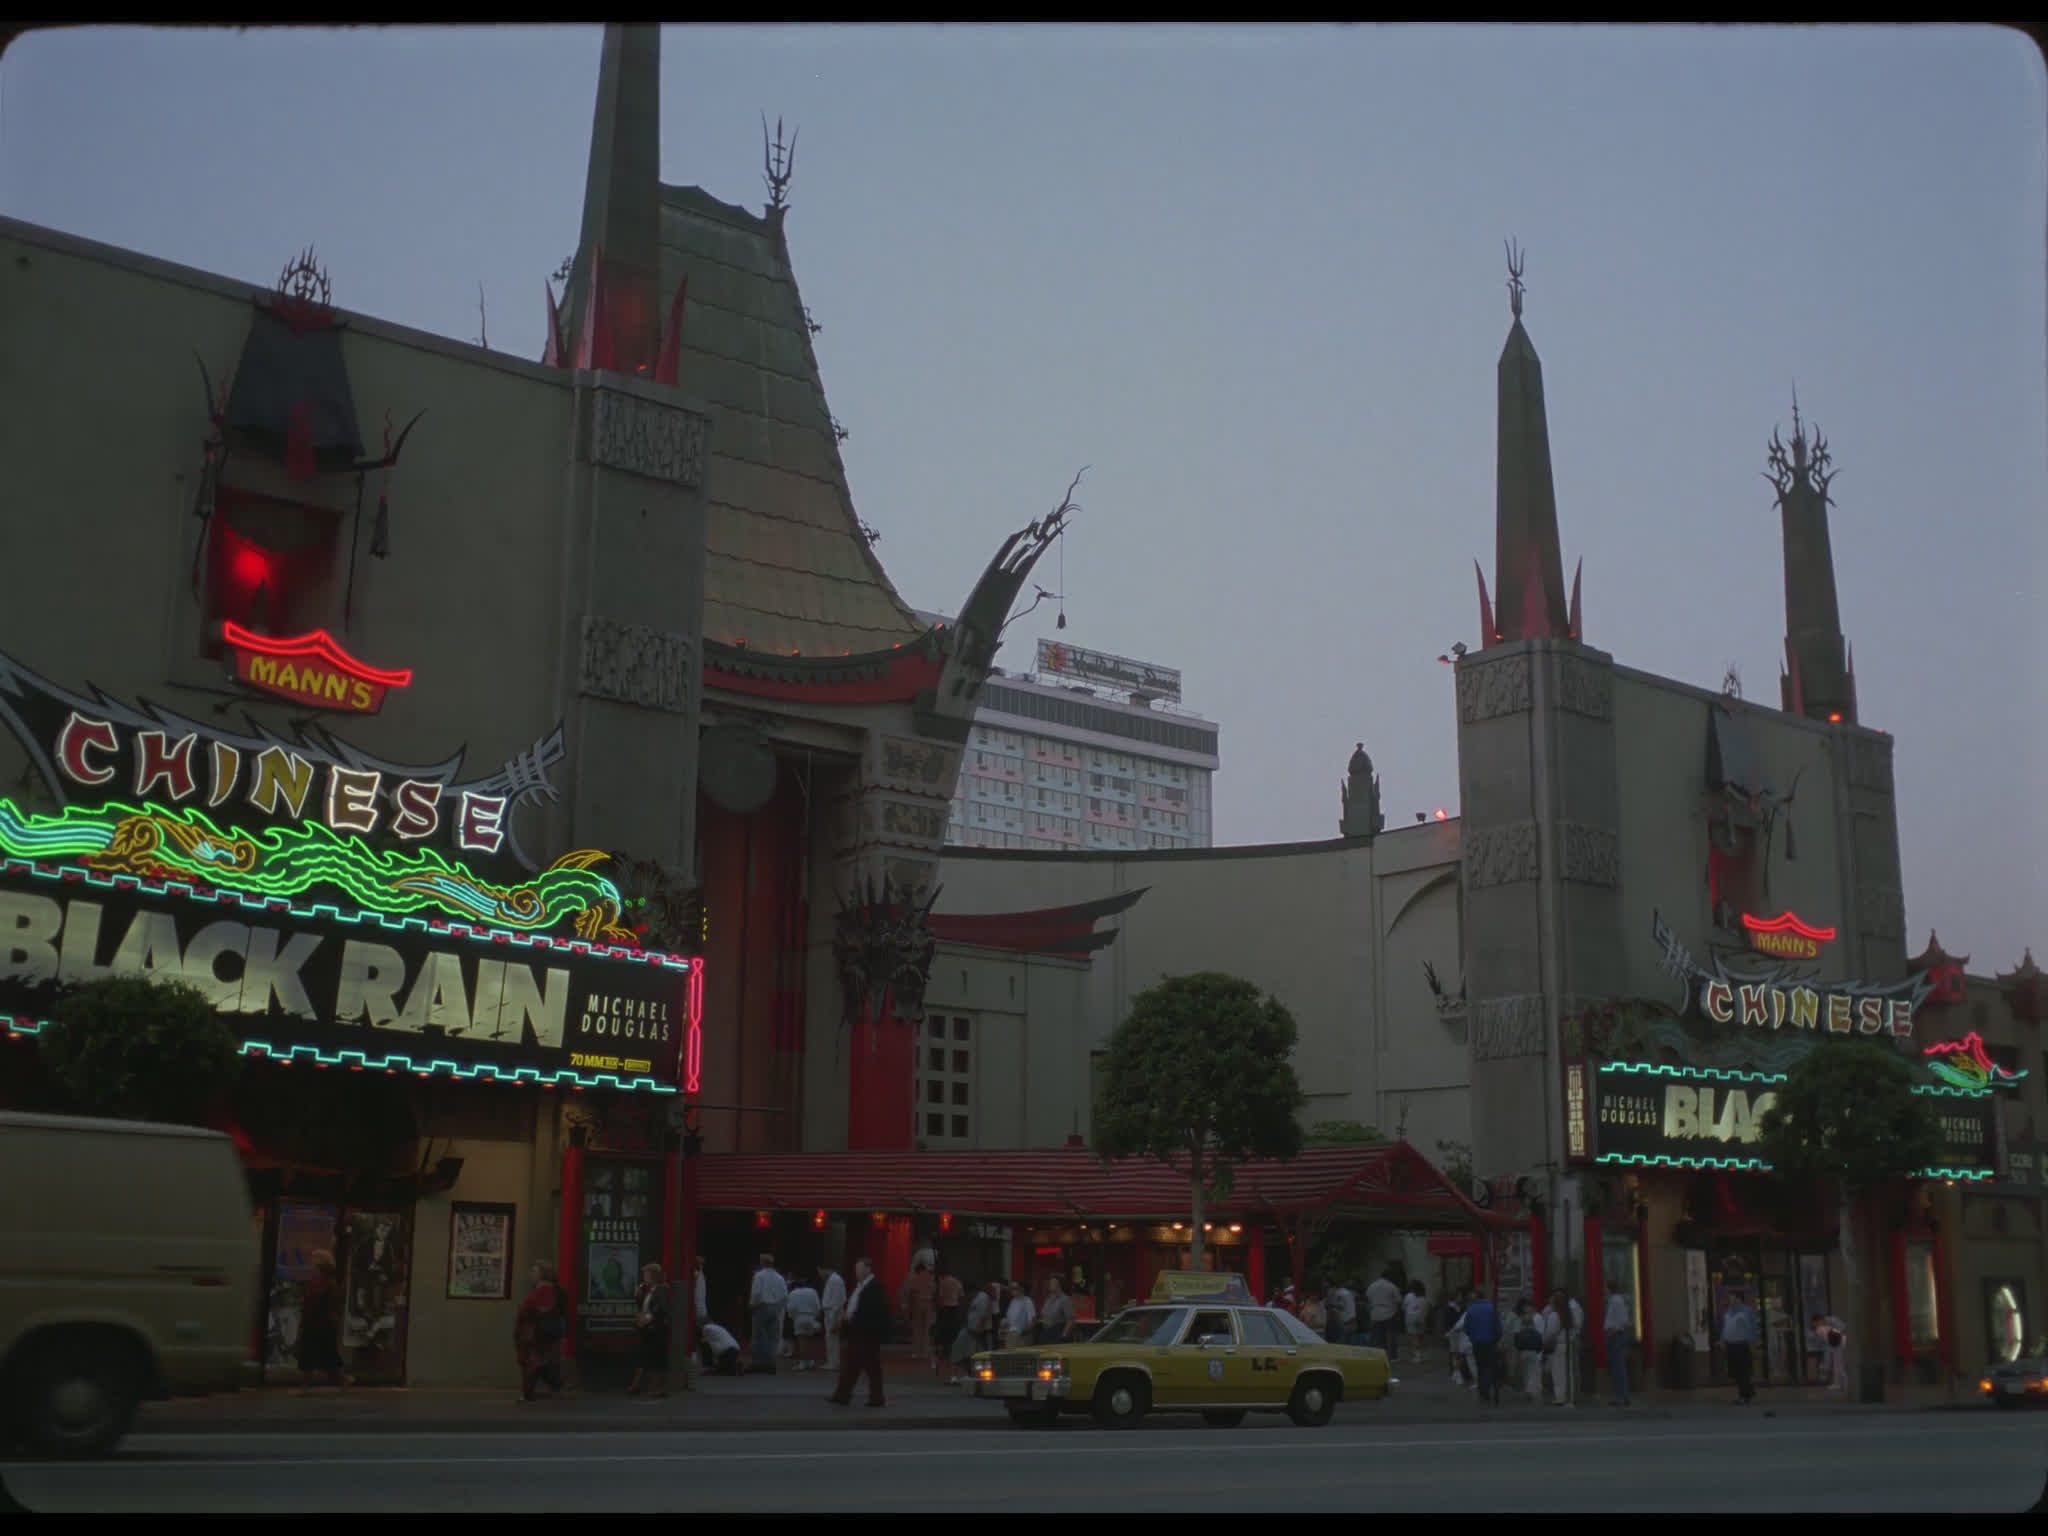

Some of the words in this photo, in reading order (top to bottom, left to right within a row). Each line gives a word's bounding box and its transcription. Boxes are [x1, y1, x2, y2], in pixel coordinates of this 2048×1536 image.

[250, 656, 374, 709] MANN'S
[60, 711, 507, 854] CHINESE
[0, 889, 325, 1021] BLACK
[334, 939, 571, 1049] RAIN
[580, 1013, 670, 1041] DOUGLAS
[587, 993, 668, 1022] MICHAEL
[1707, 980, 1913, 1037] CHINESE
[1600, 1109, 1657, 1126] DOUGLAS
[1603, 1095, 1656, 1111] MICHAEL
